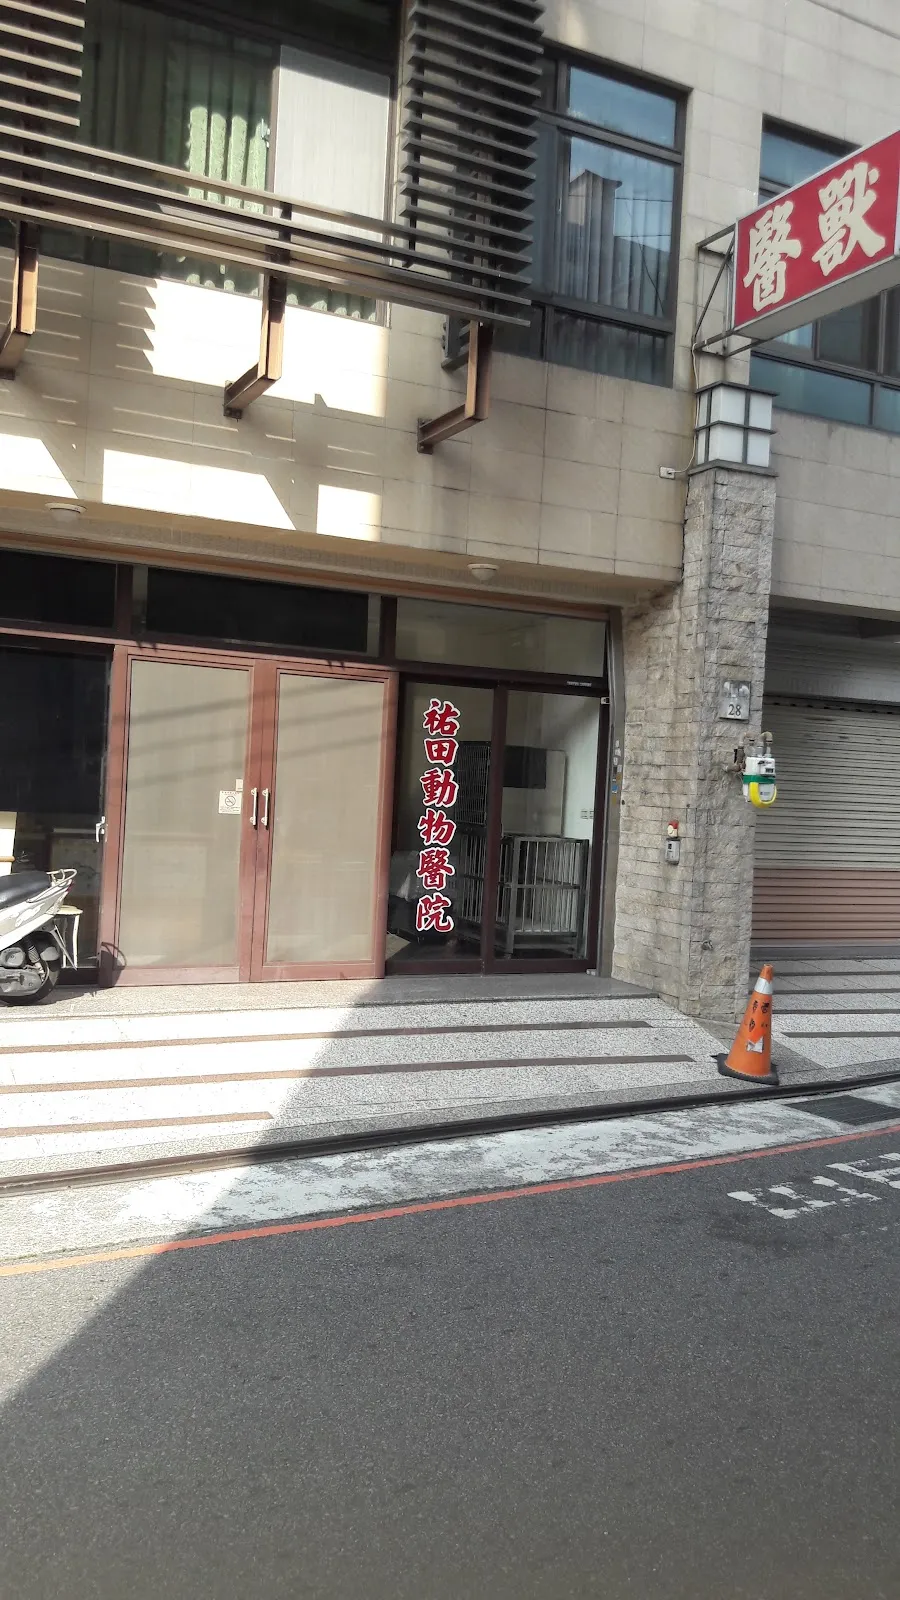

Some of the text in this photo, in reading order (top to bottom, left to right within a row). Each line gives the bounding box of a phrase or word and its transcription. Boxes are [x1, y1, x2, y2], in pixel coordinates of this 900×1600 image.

[728, 704, 741, 716] 28
[416, 698, 460, 932] 祐田動物醫院
